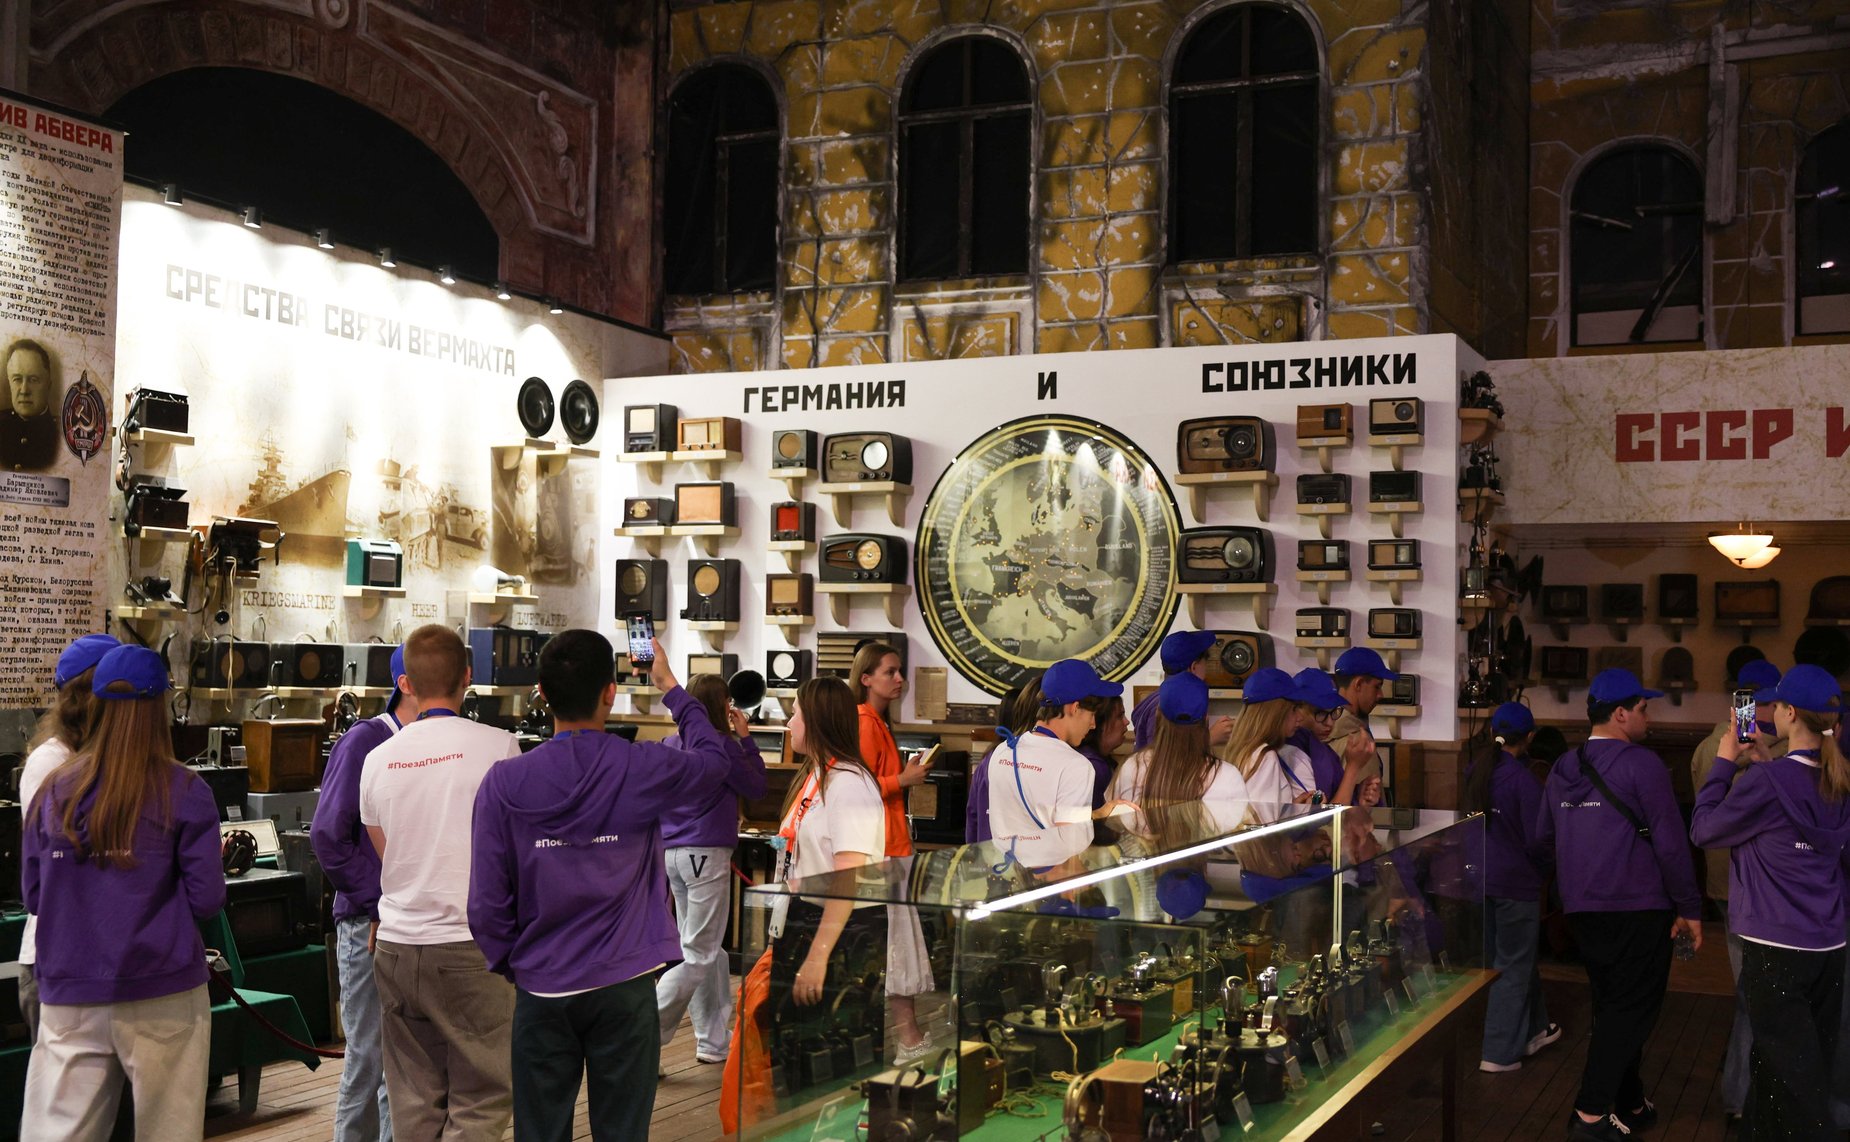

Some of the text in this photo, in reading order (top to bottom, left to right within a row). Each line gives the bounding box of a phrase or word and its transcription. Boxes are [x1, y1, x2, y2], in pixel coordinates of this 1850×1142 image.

[35, 113, 113, 154] АБВЕРА
[21, 148, 36, 158] для
[38, 153, 94, 174] дезинформации
[30, 140, 49, 151] века
[59, 148, 113, 169] использование
[2, 170, 112, 203] годы Великой Отечественной
[17, 193, 26, 201] не
[32, 197, 58, 210] только
[20, 203, 47, 218] работу
[22, 215, 40, 226] всем
[30, 227, 75, 245] инициативу,
[24, 235, 65, 251] противника
[68, 246, 91, 258] против
[54, 252, 78, 263] данной
[43, 259, 79, 274] радиоигры
[19, 265, 71, 282] проводившиеся
[73, 277, 107, 290] советской
[27, 285, 63, 300] вражеских
[65, 294, 96, 307] агентов.
[53, 282, 107, 300] использованием
[26, 295, 59, 309] радиоигр
[60, 302, 92, 316] решалась
[0, 310, 106, 337] противнику дезинформирован-
[7, 302, 106, 328] регулярную помощь Красной
[325, 303, 401, 351] СВЯЗИ
[409, 324, 515, 377] ВЕРМАХТА
[743, 353, 1416, 413] ГЕРМАНИЯ И СОЮЗНИКИ
[1616, 408, 1795, 463] СССР
[25, 486, 59, 497] Яковлевич
[4, 514, 22, 522] всей
[25, 515, 47, 525] войны
[49, 518, 77, 527] тяжелая
[23, 526, 61, 536] разведкой
[64, 529, 84, 538] легла
[86, 531, 95, 539] на
[51, 546, 94, 559] Григоренко,
[12, 573, 46, 586] Курском,
[50, 576, 93, 587] Белорусская
[4, 594, 26, 604] войск
[37, 597, 67, 606] примеры
[243, 591, 336, 610] KRIEGSMARINE
[20, 606, 54, 616] которых,
[65, 607, 77, 615] той
[412, 603, 437, 618] HEER
[517, 611, 568, 627] LUFTWAFFE
[27, 616, 58, 625] оказала
[64, 617, 91, 626] влияние
[36, 627, 67, 636] органов
[12, 635, 67, 646] дезинформации
[387, 752, 464, 769] #ПоездПамяти
[689, 854, 708, 878] V
